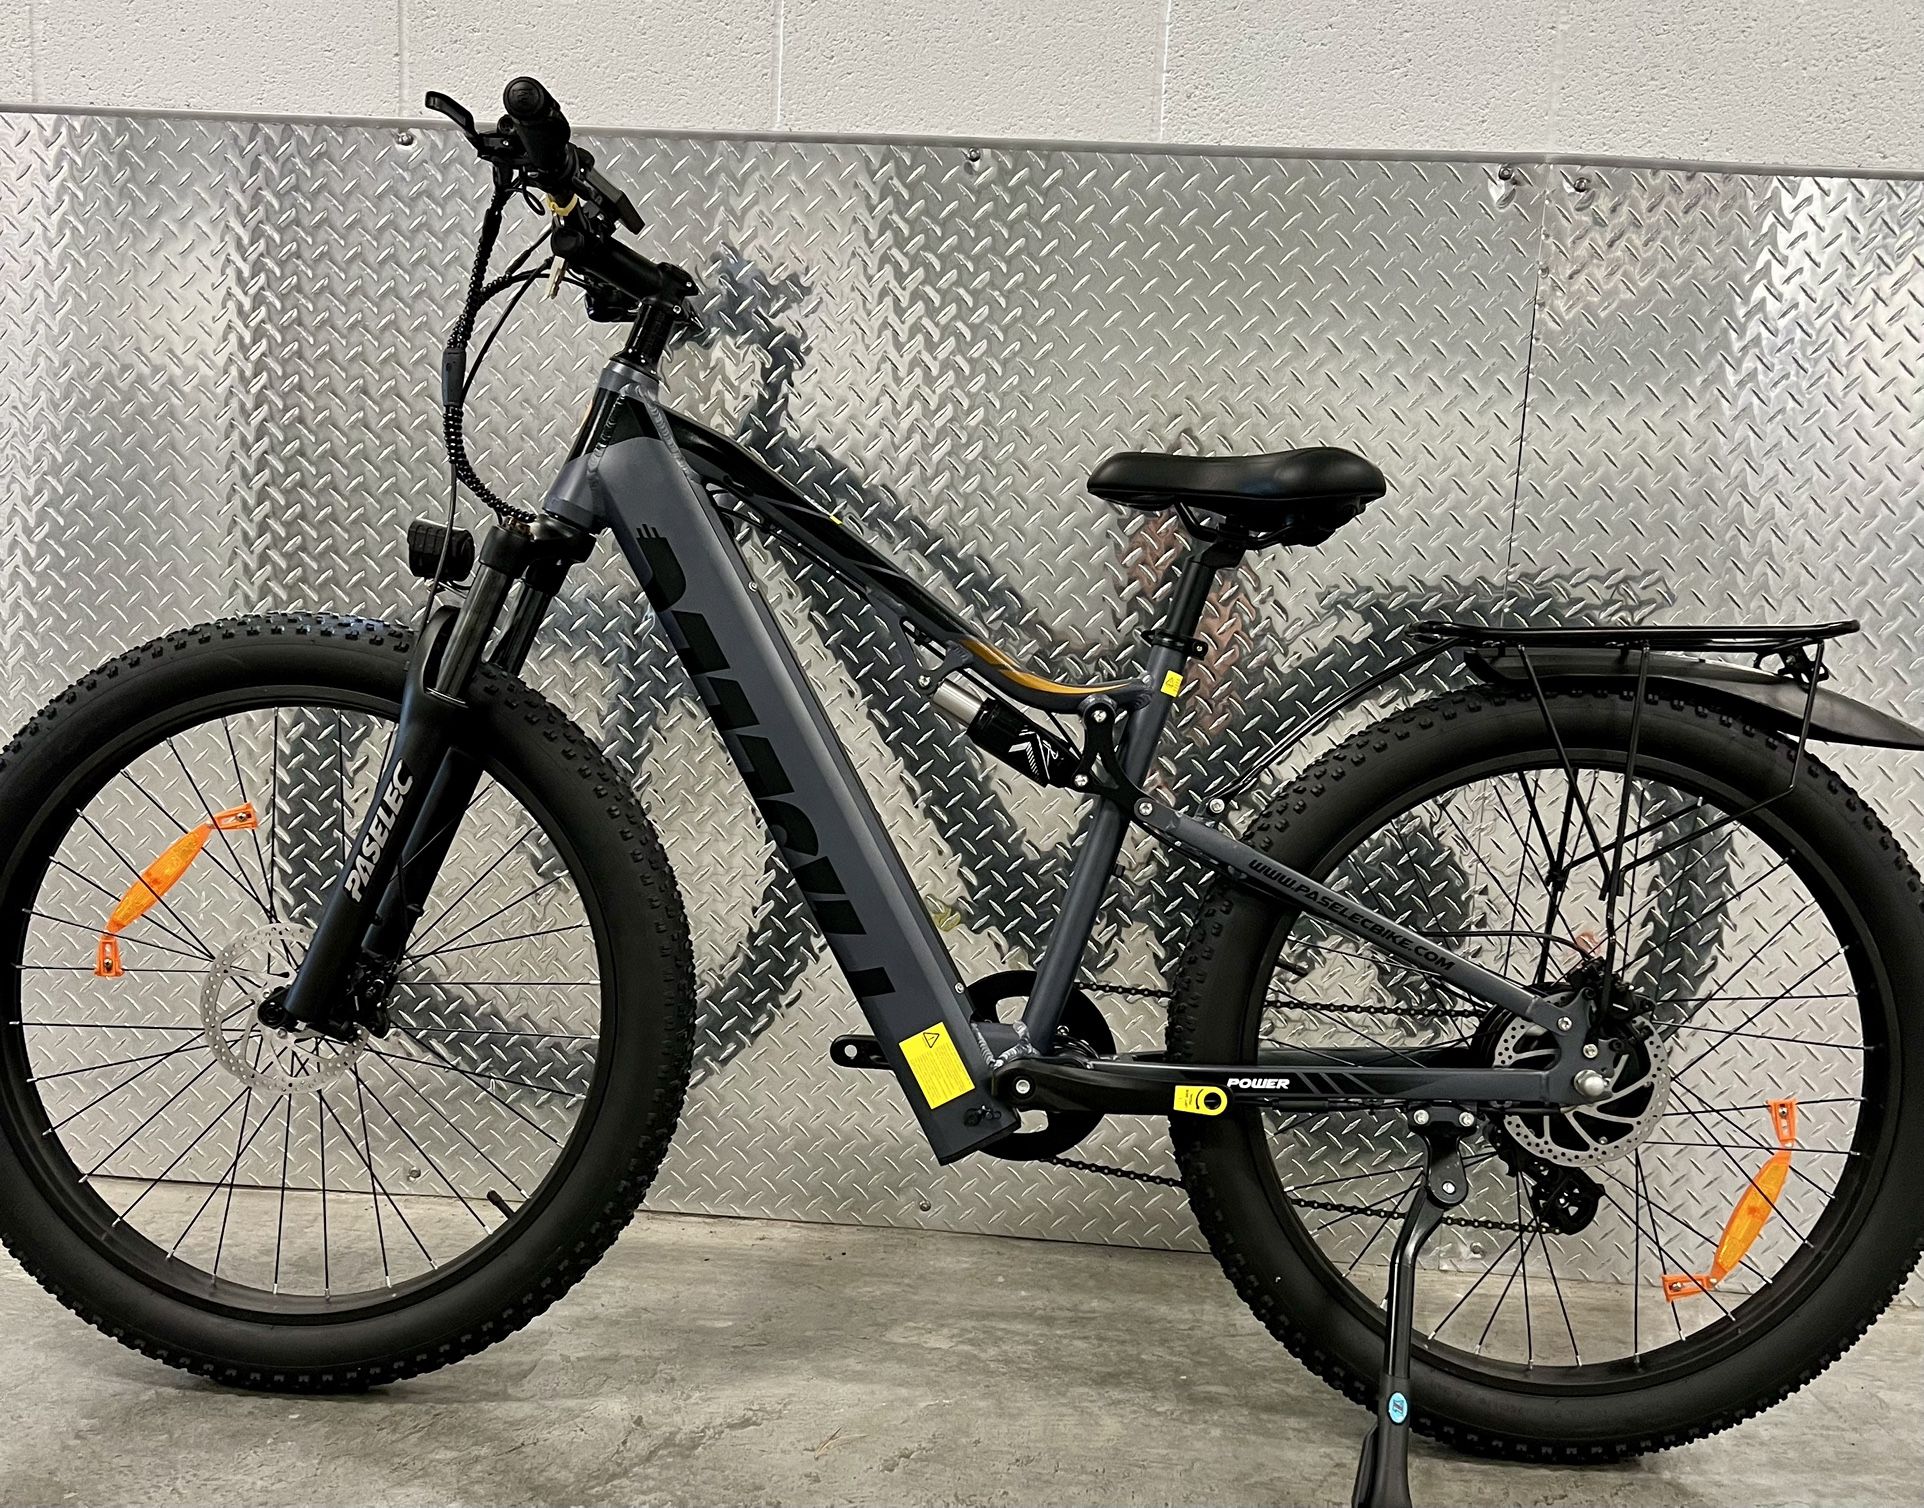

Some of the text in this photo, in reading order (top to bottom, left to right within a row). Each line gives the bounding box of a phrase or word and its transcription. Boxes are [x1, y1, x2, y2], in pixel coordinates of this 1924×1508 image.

[344, 759, 413, 902] PASELEC
[1249, 859, 1455, 971] WWW.PASELECBIKE.COM
[1227, 1078, 1290, 1090] POWER
